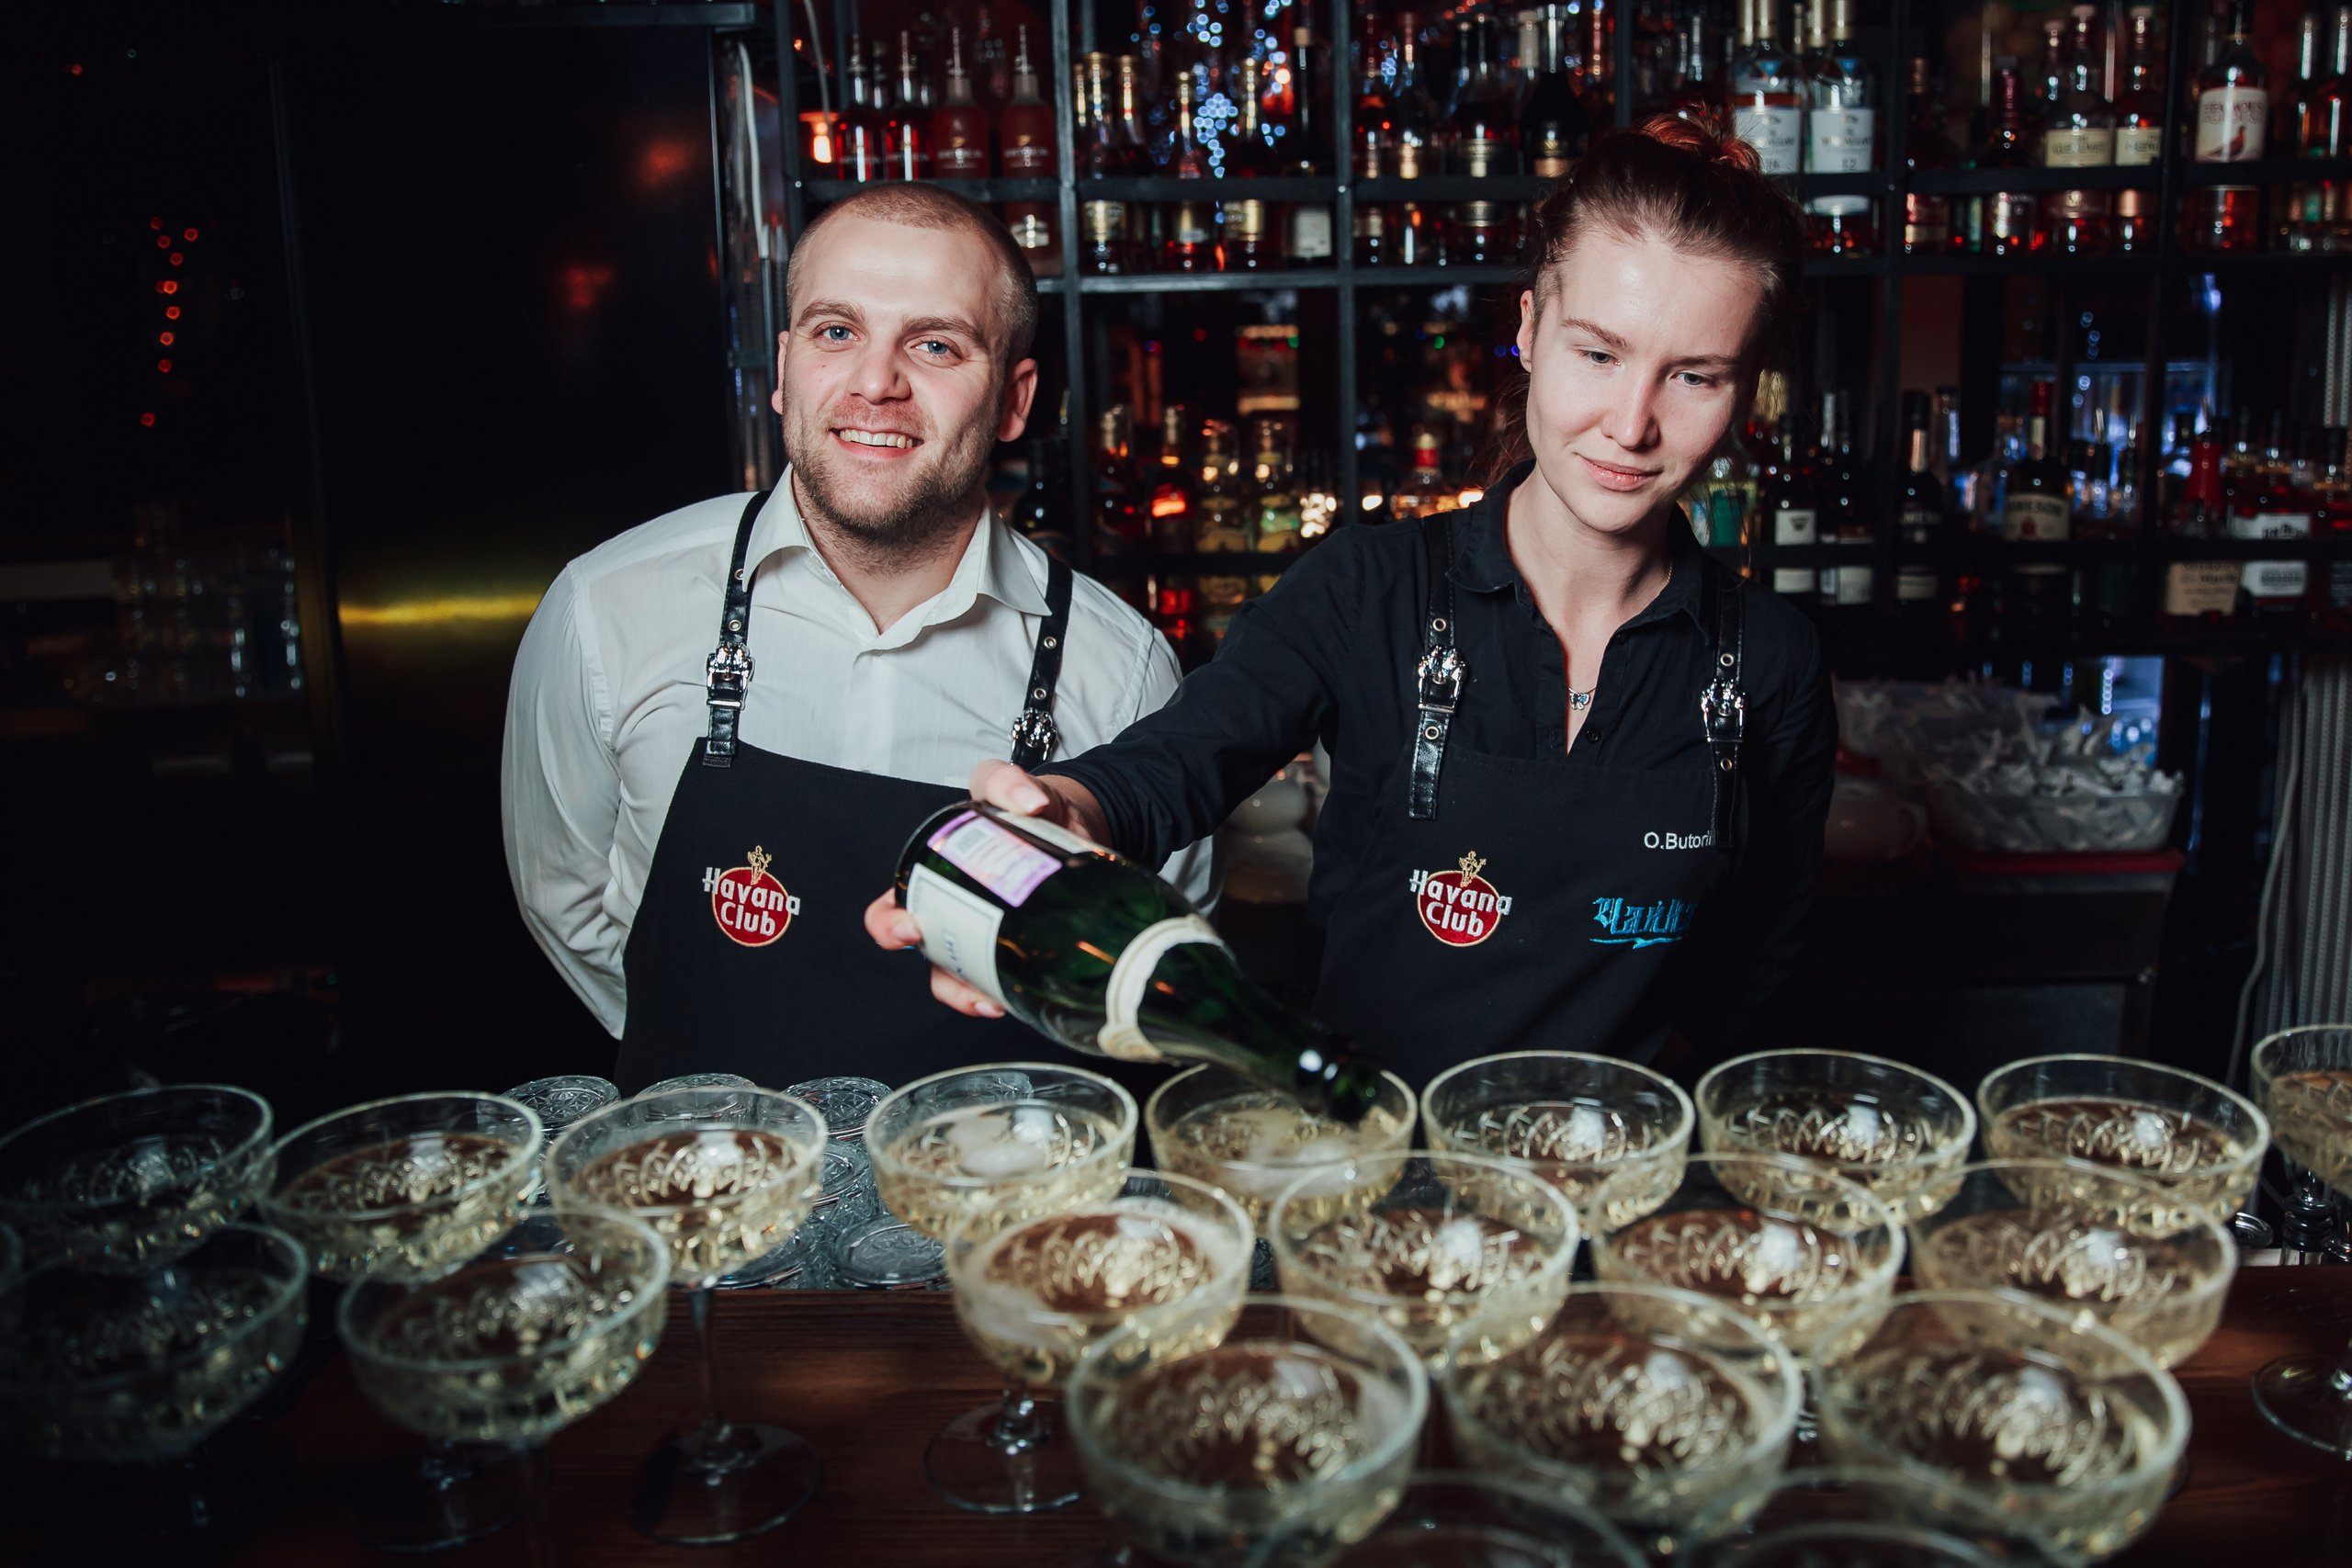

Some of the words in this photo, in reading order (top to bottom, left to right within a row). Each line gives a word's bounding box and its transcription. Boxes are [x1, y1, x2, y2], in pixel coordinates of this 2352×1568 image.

[702, 866, 801, 916] Havana
[1408, 869, 1512, 916] Havana
[720, 901, 775, 937] Club
[1426, 901, 1484, 937] Club
